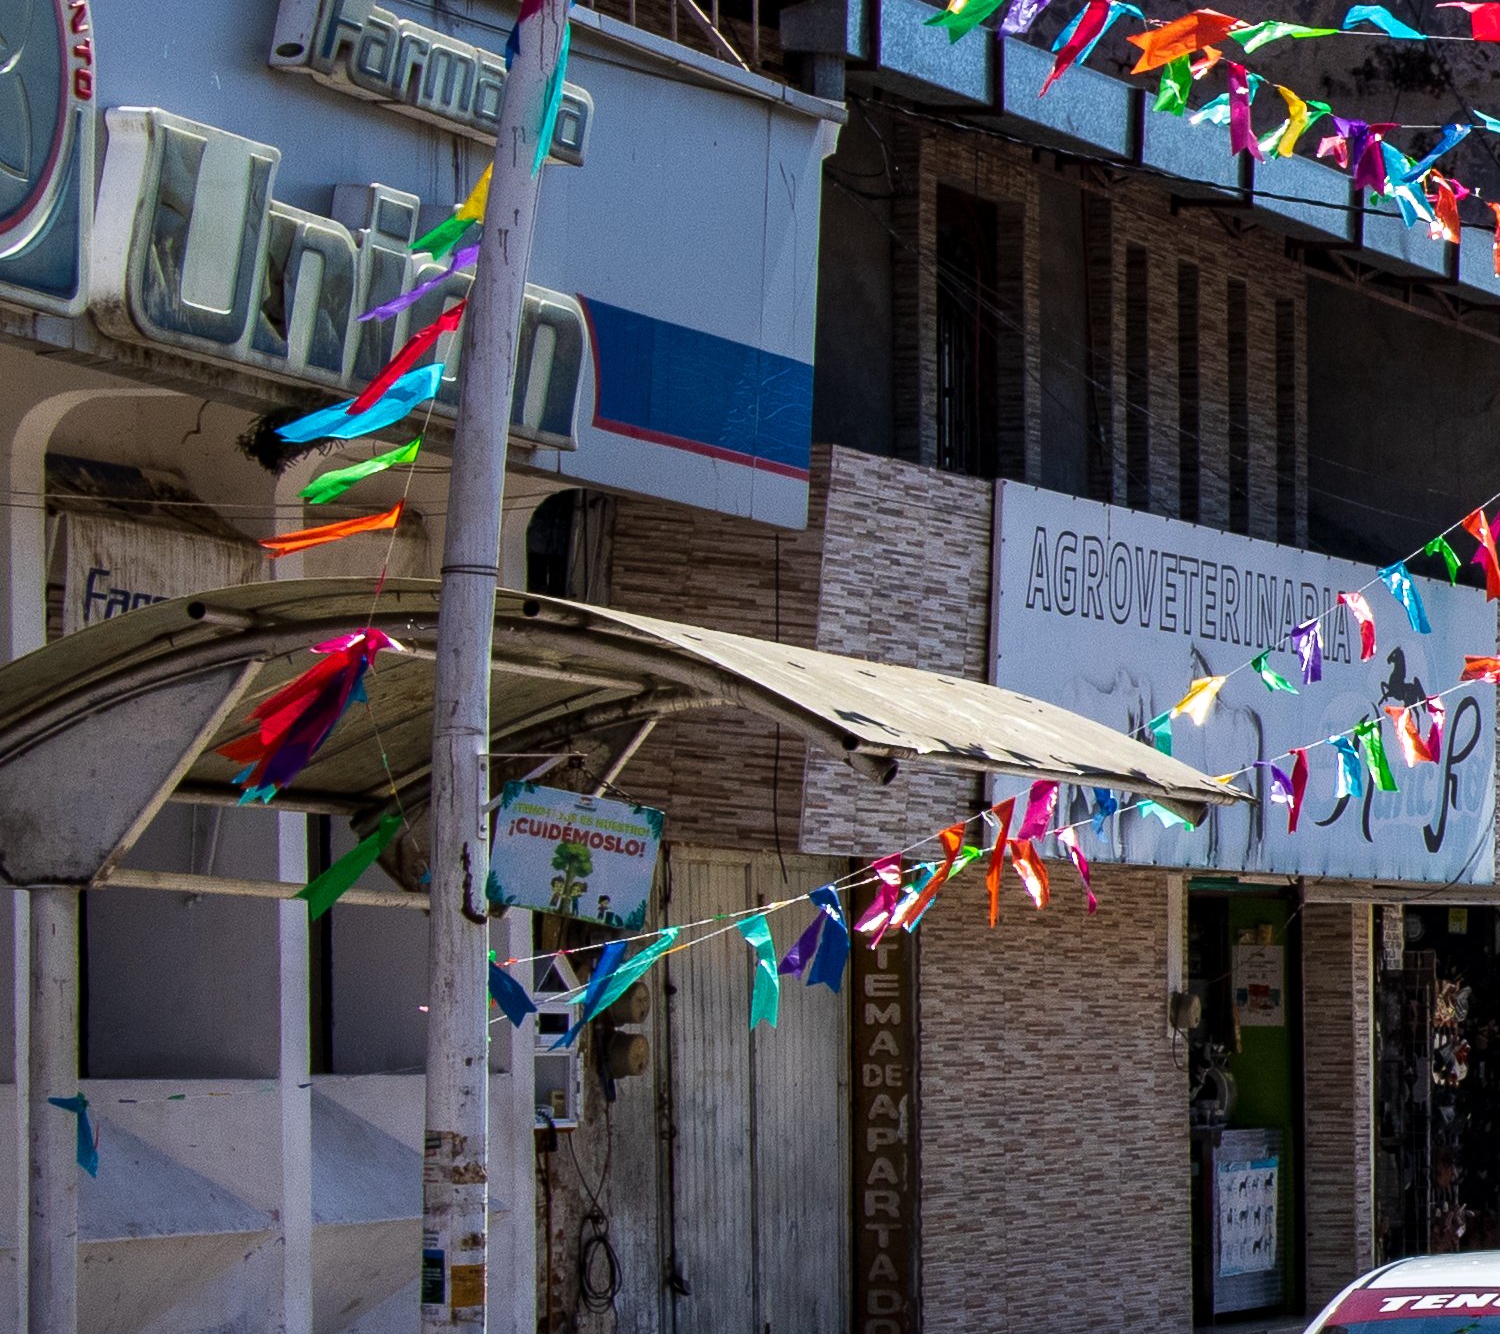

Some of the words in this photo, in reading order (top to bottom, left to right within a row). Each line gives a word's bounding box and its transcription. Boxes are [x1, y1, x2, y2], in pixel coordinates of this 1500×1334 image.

[1025, 525, 1352, 664] AGROVETERINARIA
[508, 817, 647, 858] ¡CUIDÉMOSLO!
[863, 1063, 902, 1088] DE
